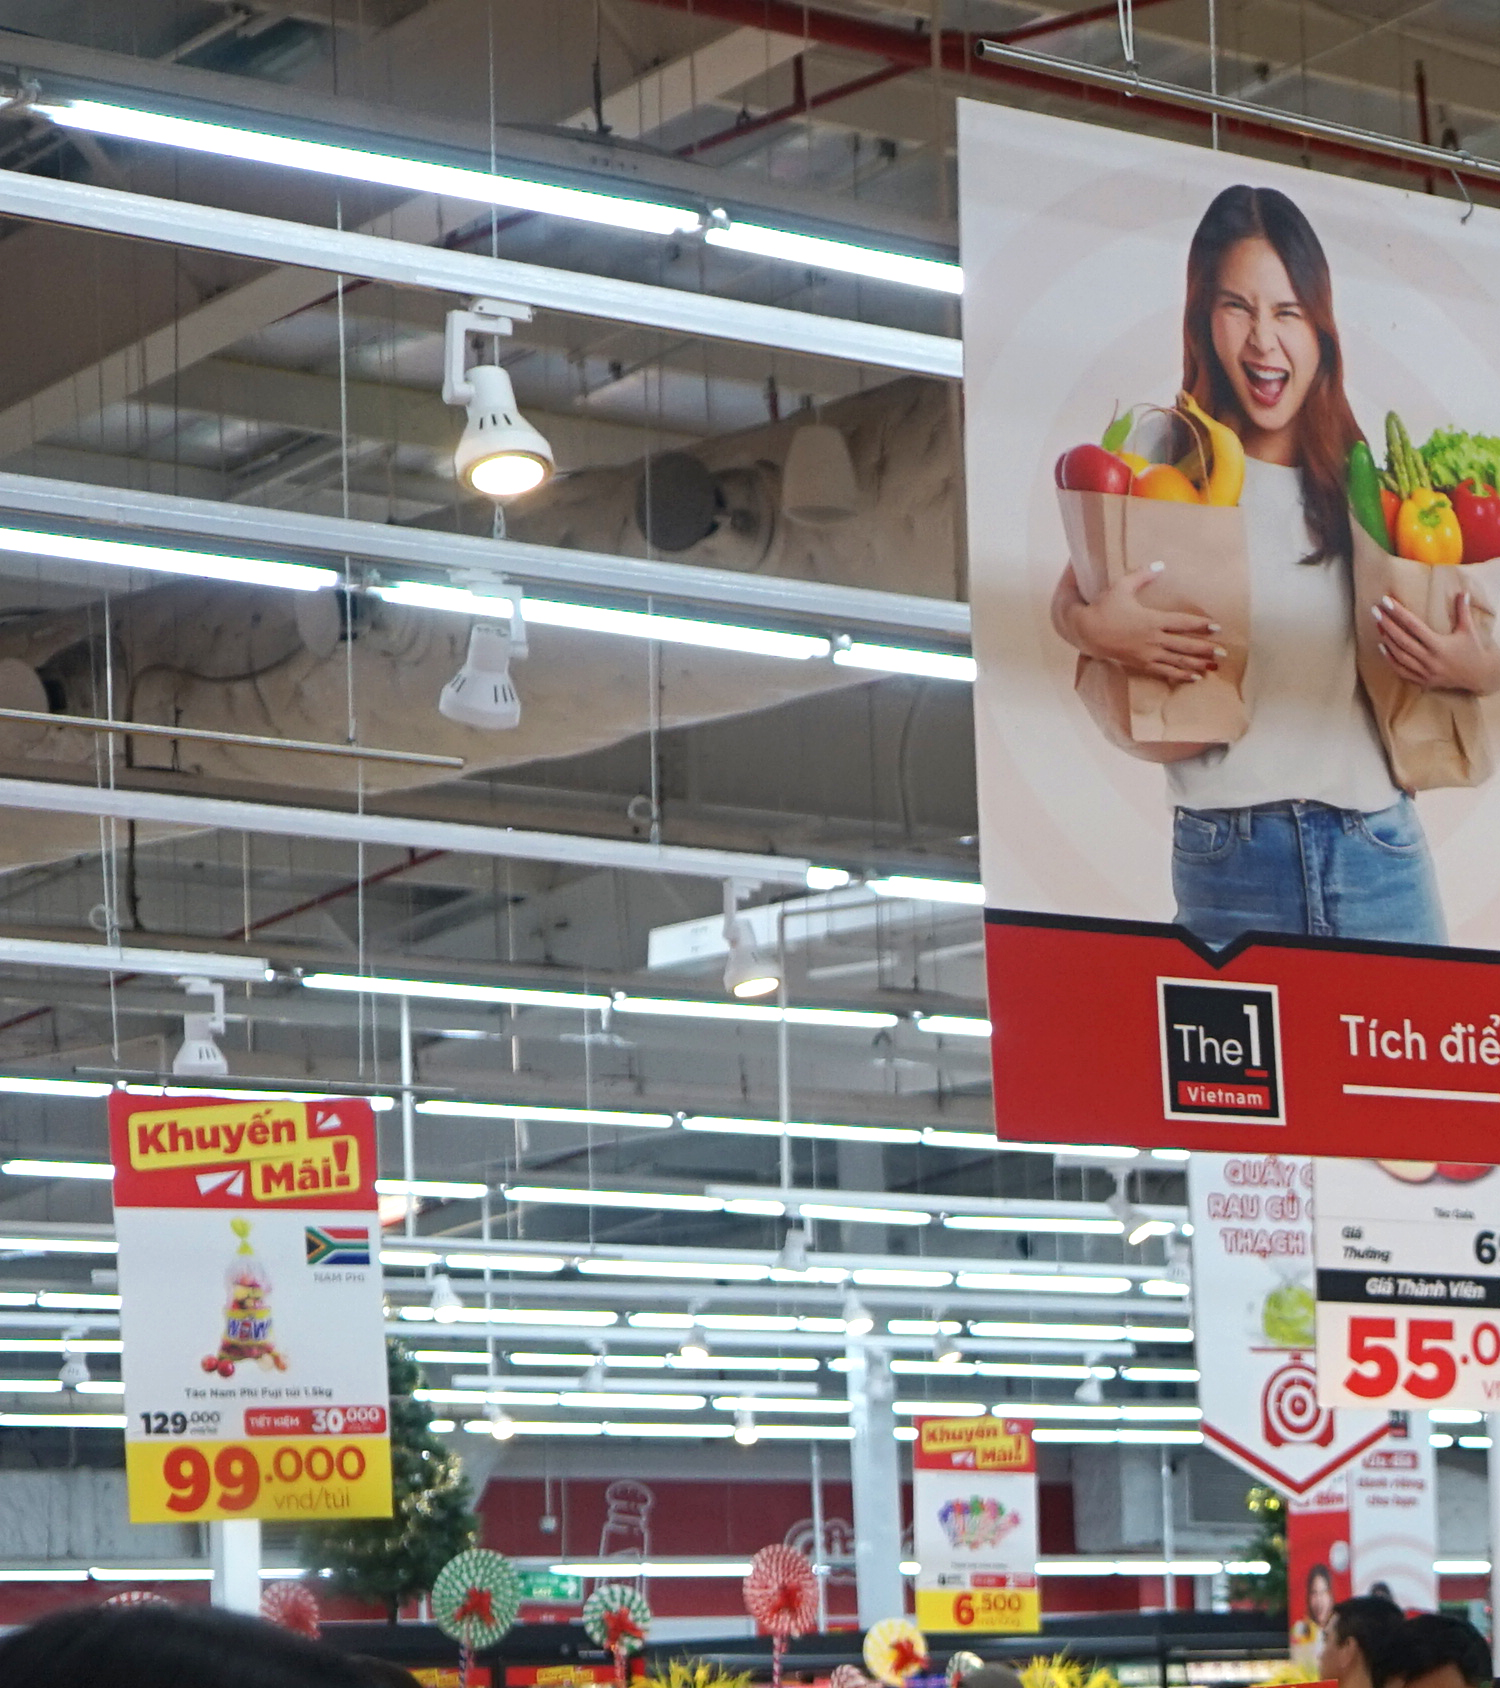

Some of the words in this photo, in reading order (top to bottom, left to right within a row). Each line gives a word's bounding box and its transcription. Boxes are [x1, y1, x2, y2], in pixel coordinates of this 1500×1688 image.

[1340, 1014, 1425, 1063] Tích
[1186, 1086, 1263, 1108] Vietnam
[137, 1109, 297, 1155] Khuyến
[261, 1141, 350, 1193] Mãi!
[163, 1446, 366, 1513] 99.000
